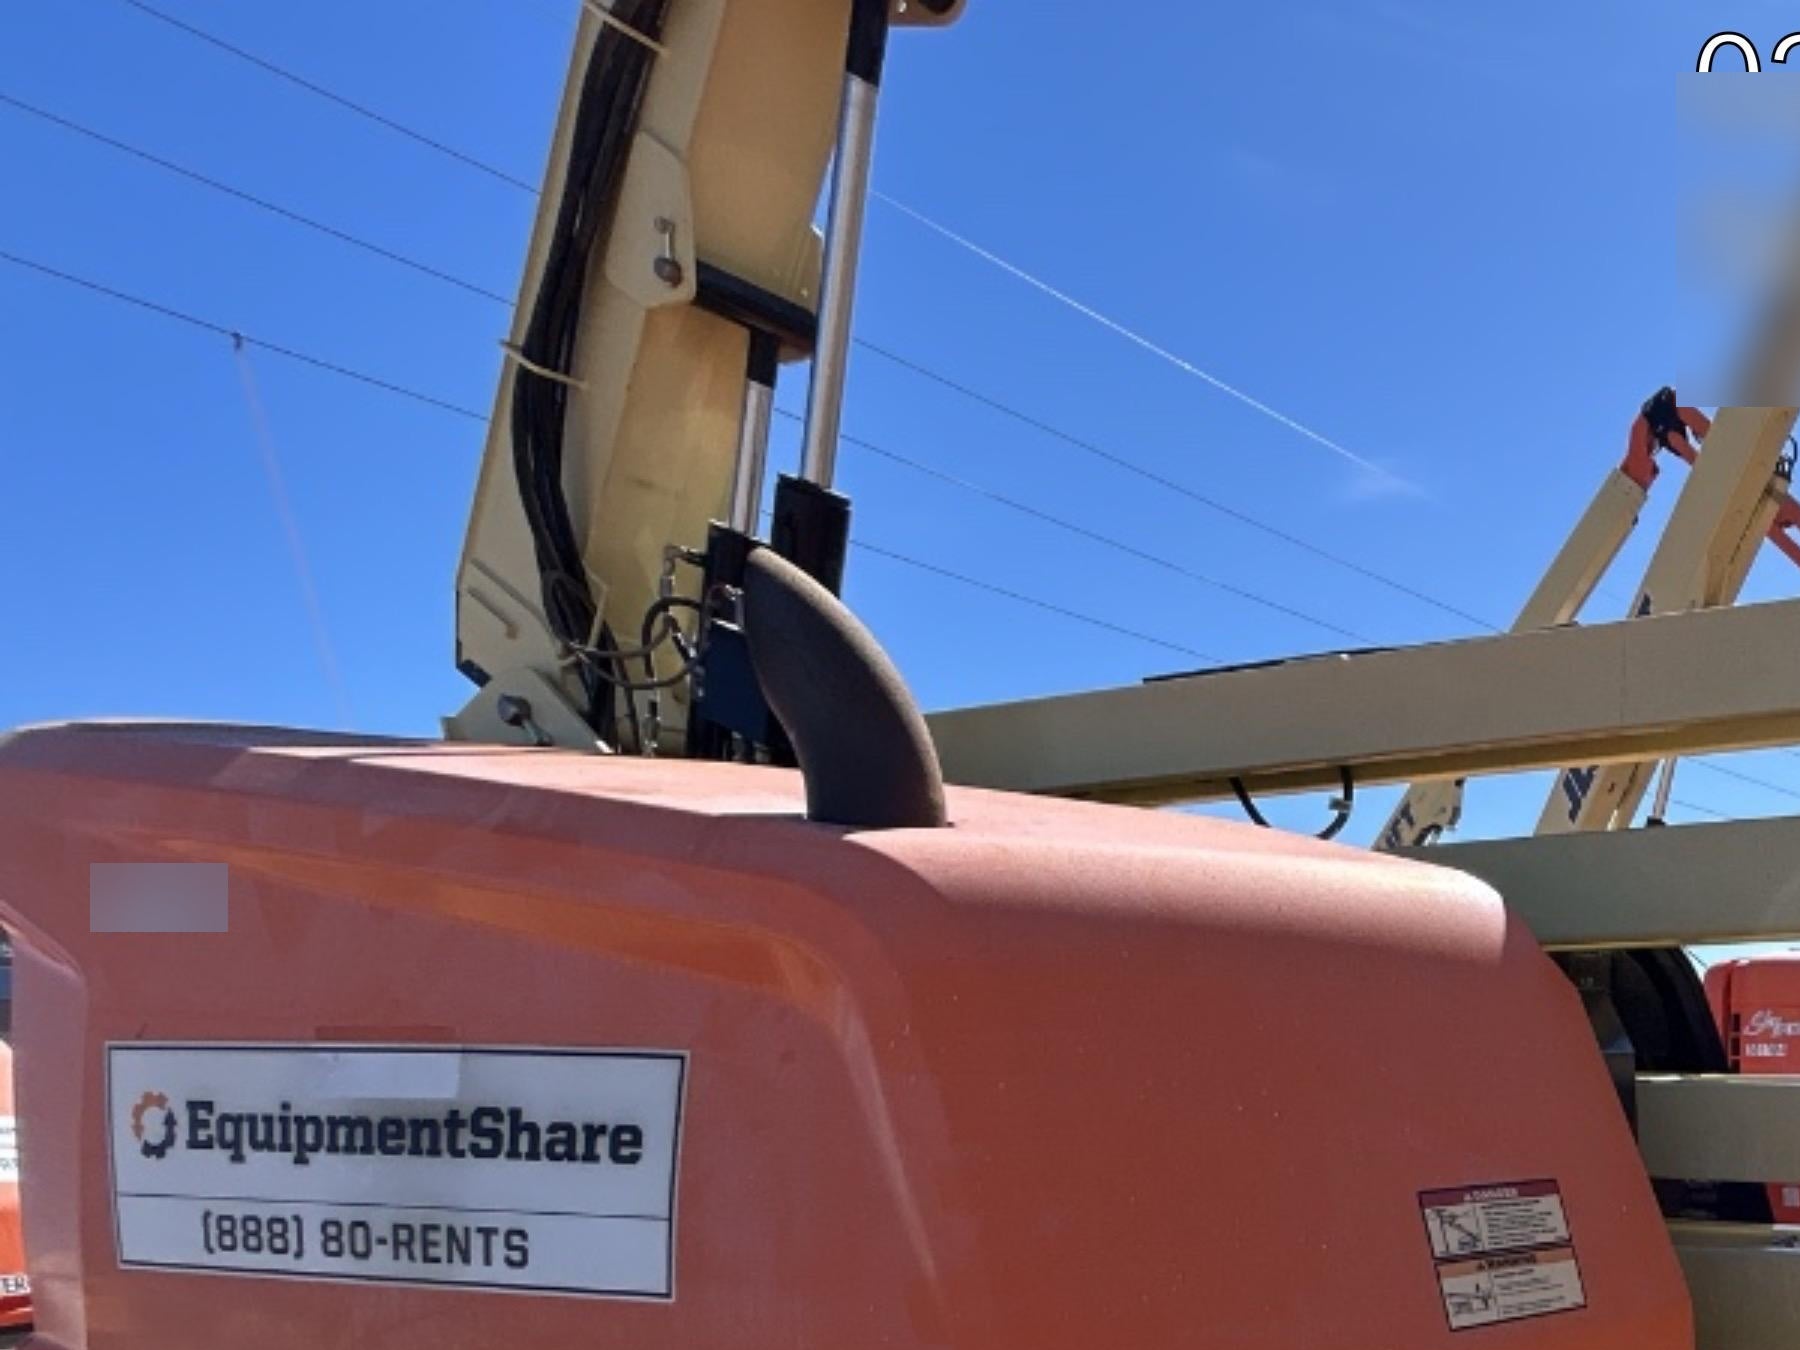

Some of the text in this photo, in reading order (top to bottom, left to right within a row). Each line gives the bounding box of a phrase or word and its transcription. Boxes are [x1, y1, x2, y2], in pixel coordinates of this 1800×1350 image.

[185, 1099, 644, 1166] EquipmentShare
[202, 1209, 530, 1270] (888) 80-RENTS
